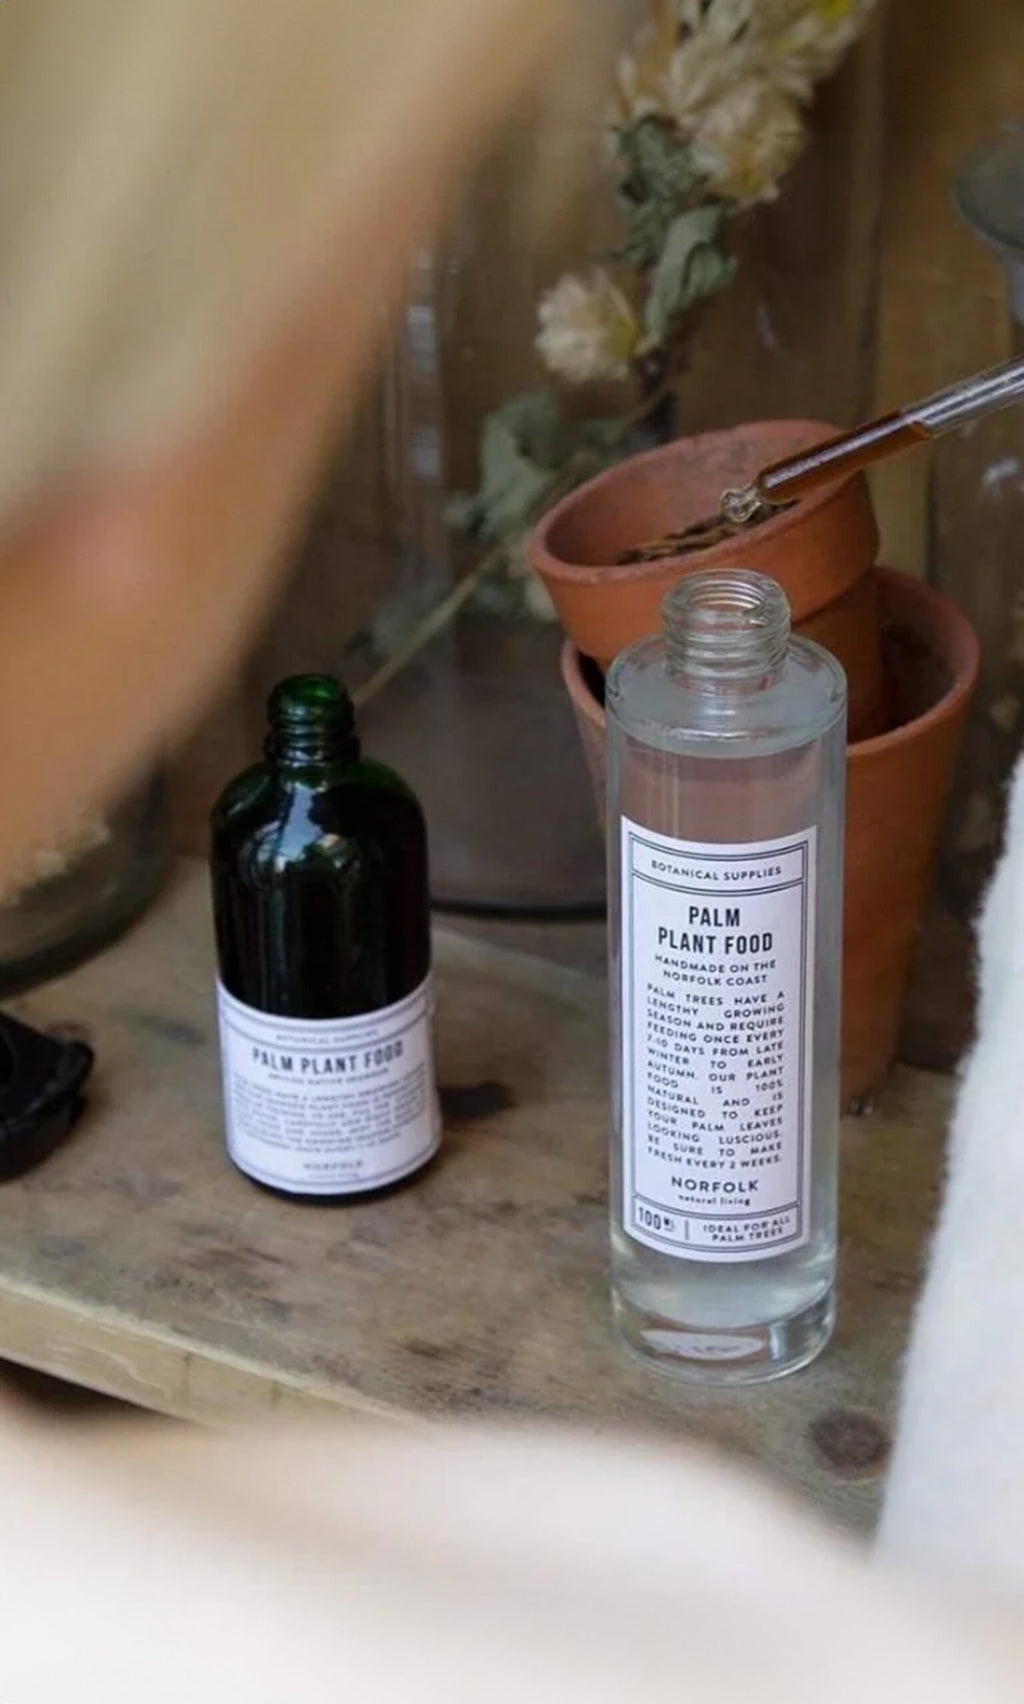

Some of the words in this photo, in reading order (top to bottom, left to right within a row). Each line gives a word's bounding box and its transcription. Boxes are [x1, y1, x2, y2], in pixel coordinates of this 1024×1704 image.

[651, 860, 719, 881] BOTANICAL
[723, 866, 782, 881] SUPPLIES
[689, 906, 740, 927] PALM
[658, 926, 716, 954] PLANT
[725, 932, 773, 955] FOOD
[654, 954, 725, 973] HANDMADE
[729, 963, 749, 973] ON
[753, 959, 776, 971] THE
[663, 970, 722, 986] NORFOLK
[726, 975, 767, 987] COAST
[646, 983, 675, 999] PALM
[685, 994, 723, 1006] TREES
[734, 994, 767, 1006] HAVE
[777, 991, 785, 999] A
[647, 996, 699, 1016] LENGTHY
[724, 1003, 785, 1019] GROWING
[647, 1009, 691, 1027] SEASON
[697, 1022, 725, 1031] AND
[730, 1016, 784, 1031] REQUIRE
[647, 1021, 697, 1042] FEEDING
[704, 1034, 739, 1044] ONCE
[746, 1029, 784, 1043] EVERY
[252, 1047, 293, 1071] PALM
[301, 1055, 357, 1075] PLANT
[365, 1040, 403, 1069] FOOD
[647, 1047, 690, 1065] WINTER
[710, 1060, 727, 1070] TO
[748, 1054, 784, 1068] EARLY
[674, 1043, 705, 1055] DAYS
[712, 1048, 749, 1057] FROM
[756, 1042, 784, 1054] LATE
[647, 1072, 679, 1089] FOOD
[711, 1086, 723, 1095] IS
[709, 1073, 736, 1082] OUR
[746, 1066, 784, 1081] PLANT
[647, 1085, 699, 1105] NATURAL
[723, 1097, 750, 1107] AND
[772, 1092, 784, 1101] IS
[647, 1097, 706, 1119] DESIGNED
[722, 1110, 738, 1120] TO
[754, 1104, 783, 1117] KEEP
[648, 1110, 677, 1125] YOUR
[692, 1121, 724, 1132] PALM
[740, 1117, 783, 1132] LEAVES
[648, 1123, 700, 1143] LOOKING
[648, 1134, 660, 1145] BE
[673, 1143, 703, 1156] SURE
[719, 1148, 736, 1157] TO
[750, 1141, 782, 1155] MAKE
[648, 1147, 682, 1164] FRESH
[686, 1158, 725, 1169] EVERY
[729, 1161, 736, 1169] 2
[671, 1175, 759, 1194] NORFOLK
[678, 1194, 716, 1205] natural
[720, 1196, 751, 1207] living
[703, 1224, 739, 1233] IDEAL
[744, 1221, 768, 1231] FOR
[772, 1215, 791, 1226] ALL
[712, 1234, 744, 1242] PALM
[749, 1227, 783, 1239] TREES
